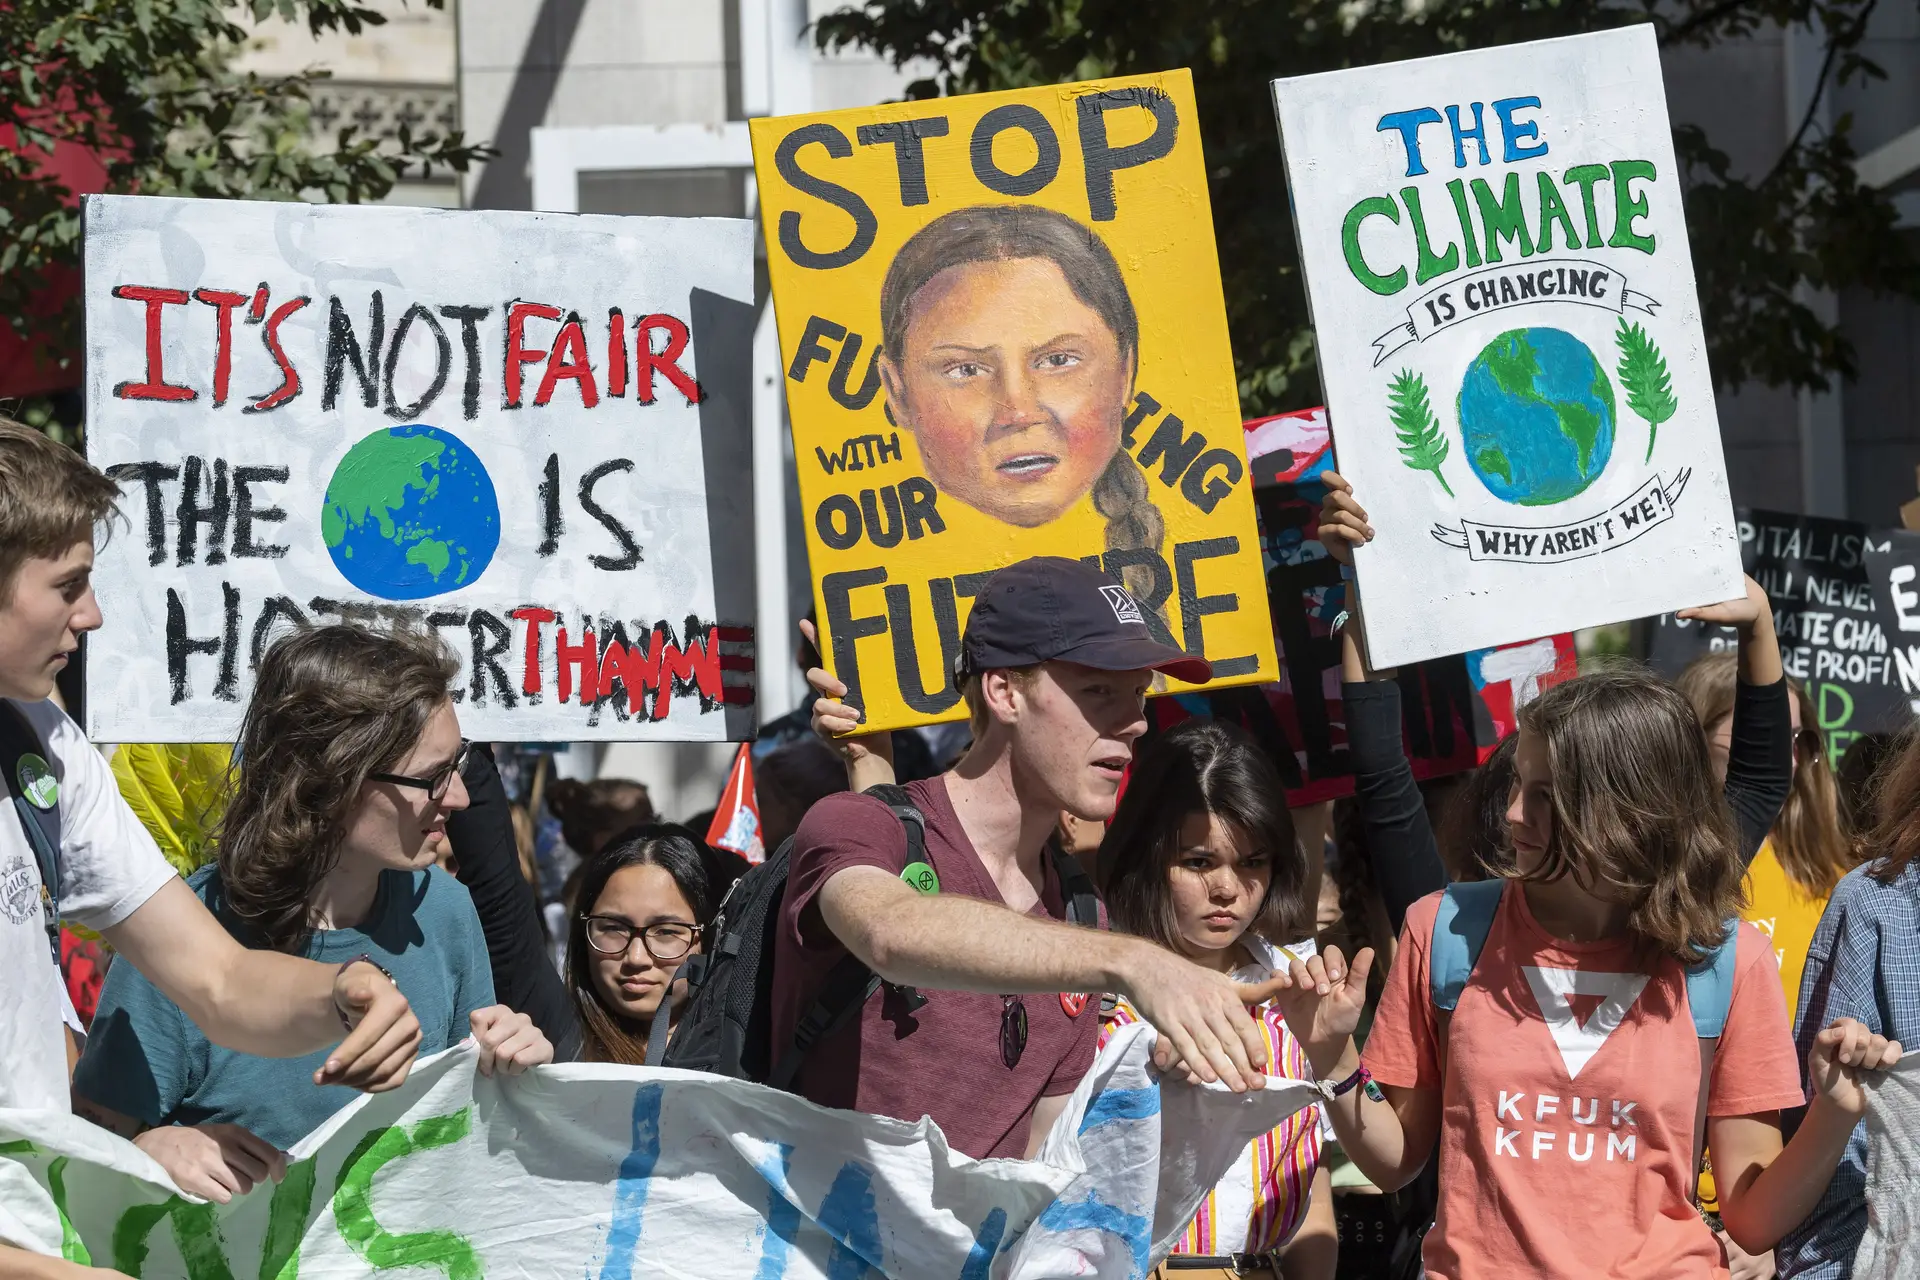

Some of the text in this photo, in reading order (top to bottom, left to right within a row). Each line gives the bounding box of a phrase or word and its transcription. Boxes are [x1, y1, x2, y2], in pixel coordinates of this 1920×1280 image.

[1377, 96, 1549, 178] THE
[774, 87, 1179, 271] STOP
[1341, 160, 1657, 297] CLIMATE
[1424, 268, 1610, 327] IS CHANGING
[111, 281, 708, 421] IT'S NOT FAIR
[787, 314, 898, 428] FU
[814, 431, 903, 476] WITH
[105, 452, 644, 571] THE IS
[815, 475, 947, 550] OUR
[1475, 487, 1667, 556] WHY AREN'T WE?
[822, 535, 1259, 726] FURE
[1805, 575, 1876, 612] NEVE
[1815, 648, 1898, 687] PROFI
[1495, 1128, 1637, 1162] KFUM
[1498, 1090, 1638, 1126] KFUK
